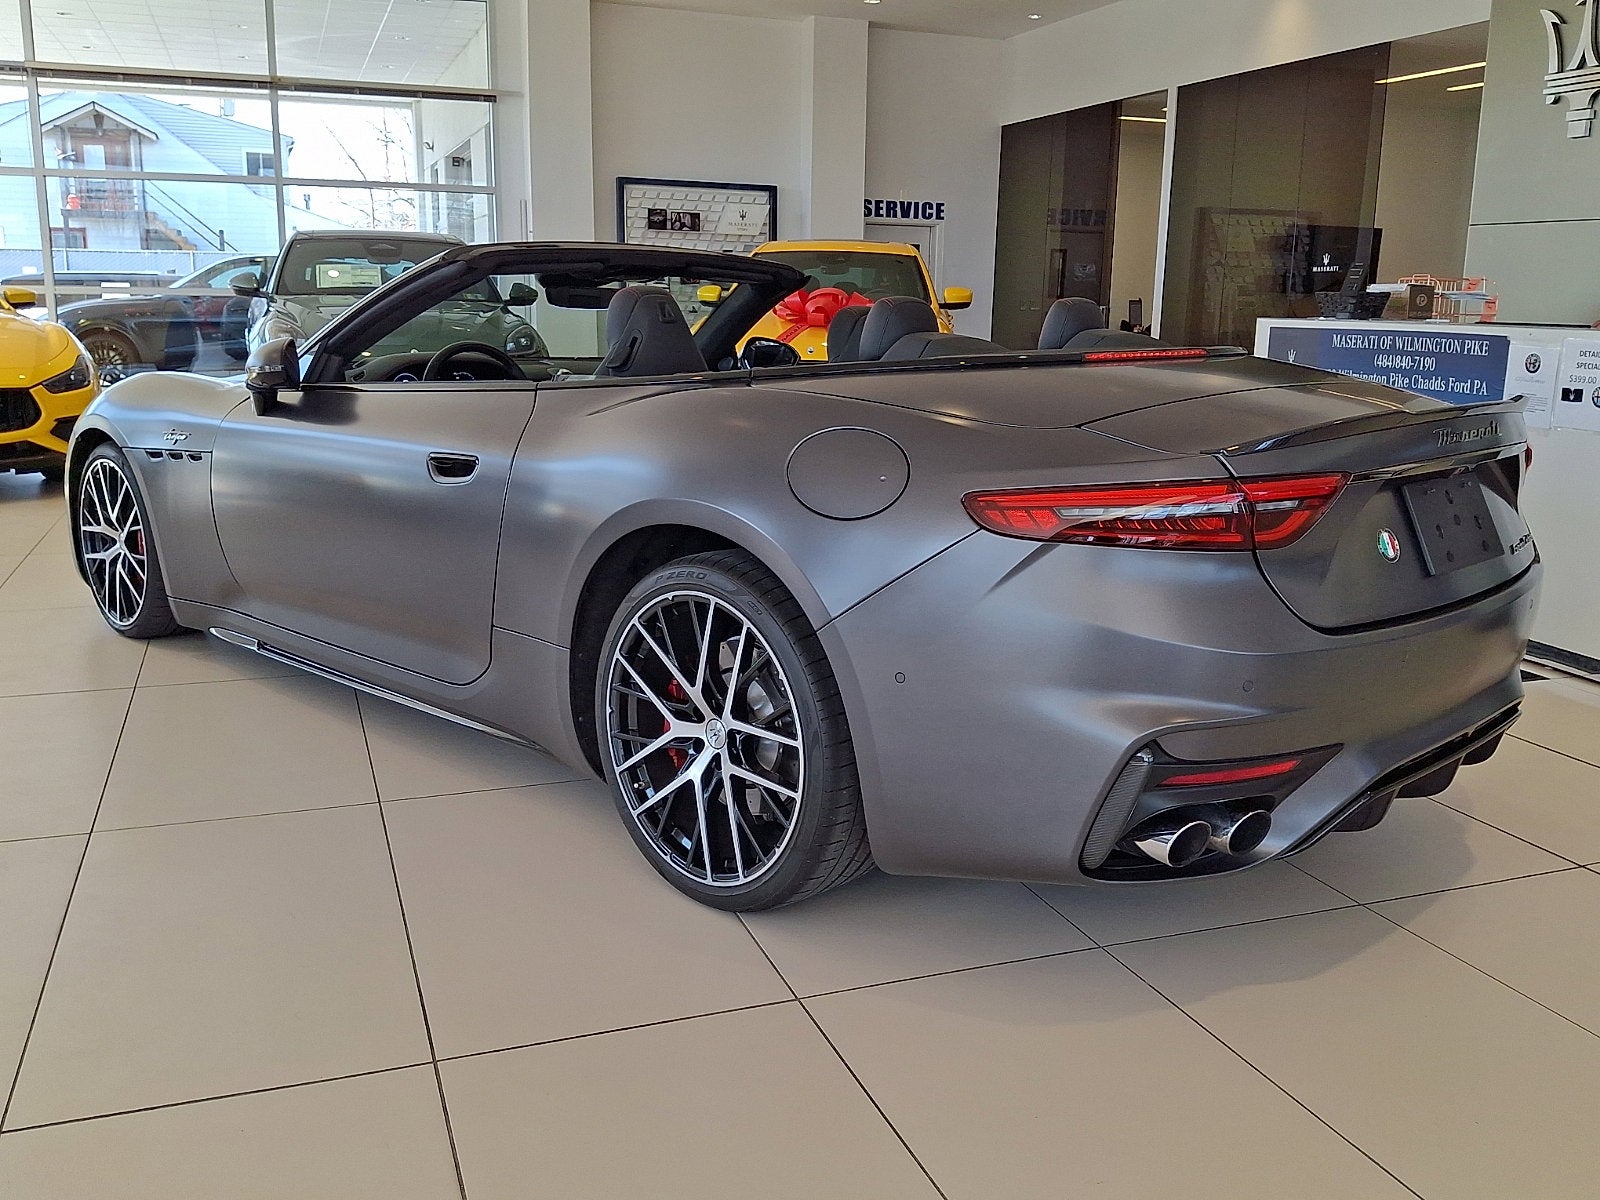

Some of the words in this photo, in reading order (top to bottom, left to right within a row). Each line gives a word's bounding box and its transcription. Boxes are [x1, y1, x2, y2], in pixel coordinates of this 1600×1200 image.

[864, 199, 945, 220] SERVICE
[1312, 265, 1339, 273] MASERATI
[1332, 334, 1379, 350] MASERATI
[1380, 336, 1393, 350] OF
[1395, 336, 1462, 354] WILMINGTON
[1463, 339, 1490, 356] PIKE
[1374, 354, 1436, 371] (484)840-7190
[1389, 372, 1409, 389] Pike
[1411, 374, 1446, 392] Chadds
[1448, 377, 1471, 395] Ford
[1473, 379, 1488, 396] PA
[1569, 374, 1597, 385] $399.00
[655, 574, 664, 585] P
[666, 570, 708, 580] ZERO
